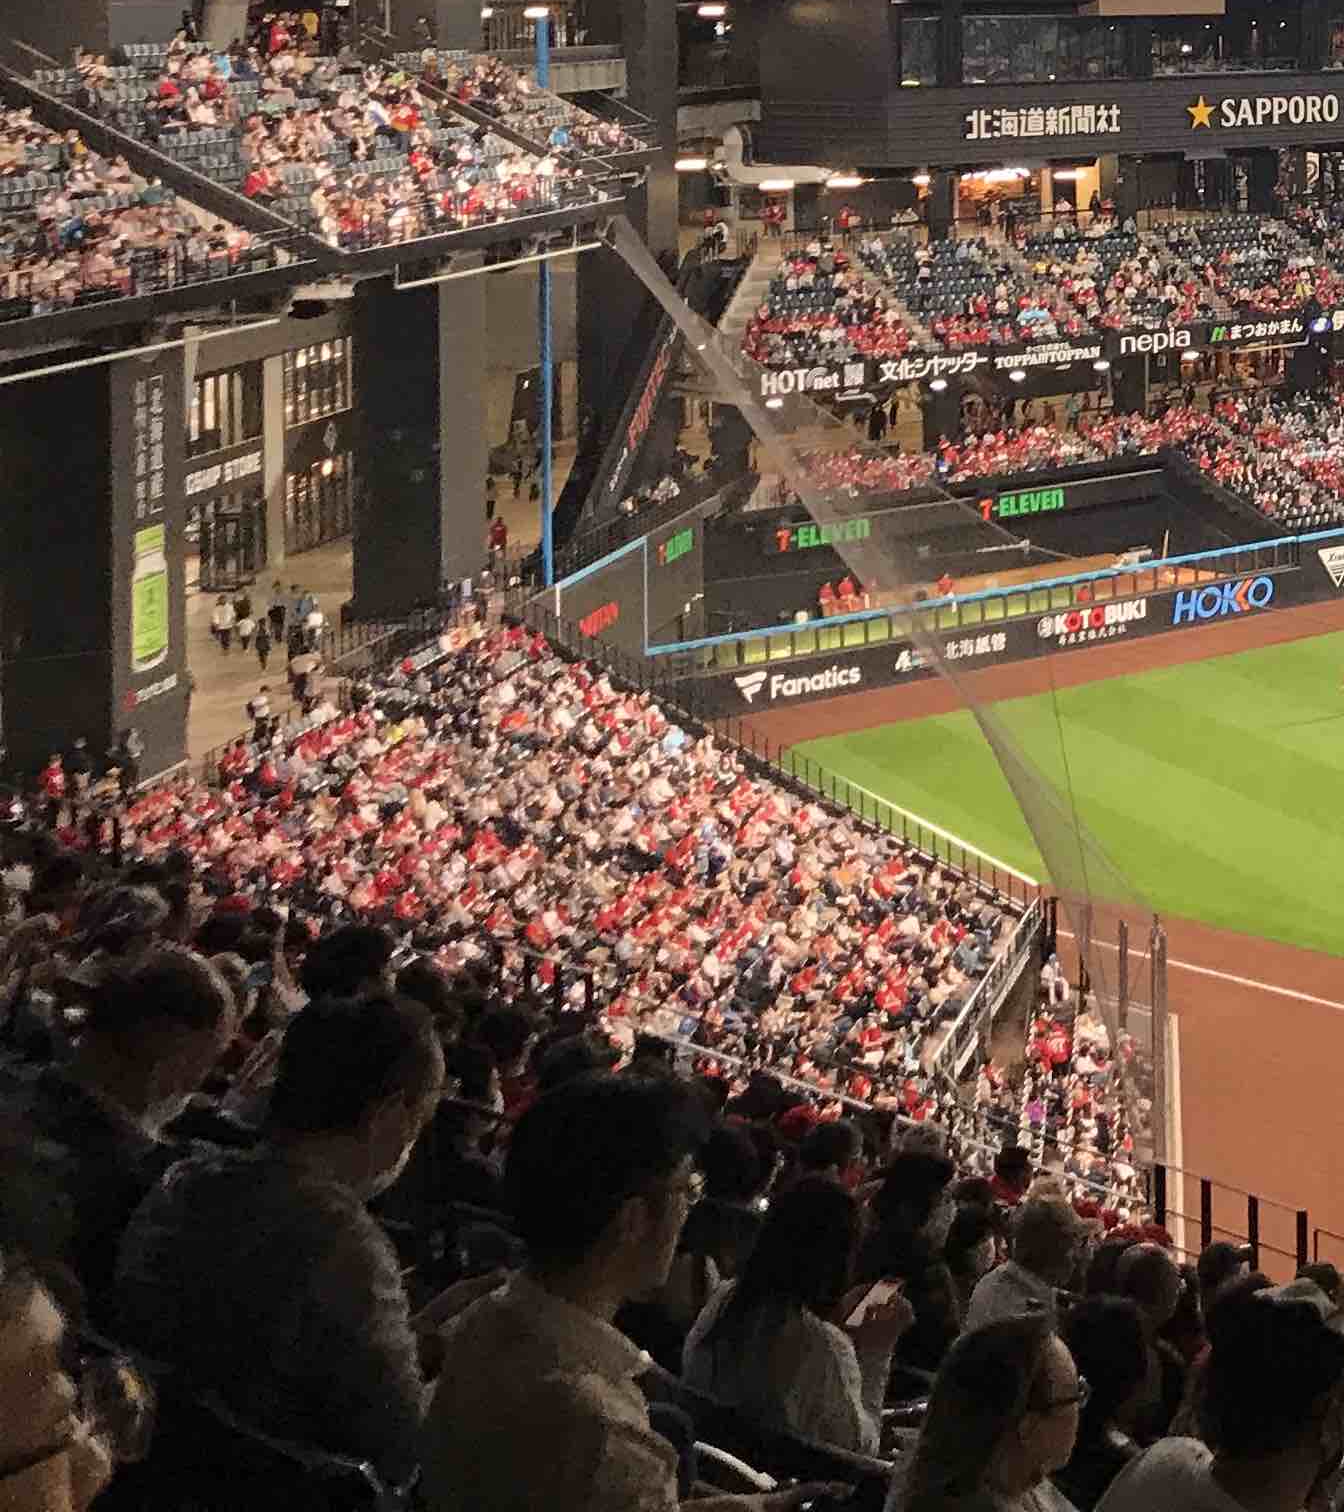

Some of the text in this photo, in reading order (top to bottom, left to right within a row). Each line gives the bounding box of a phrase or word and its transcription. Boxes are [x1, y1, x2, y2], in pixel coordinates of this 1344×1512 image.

[966, 104, 1121, 139] 北海道新聞社
[1220, 94, 1339, 128] SAPPORO
[1120, 327, 1192, 355] nepia
[1230, 318, 1304, 340] まつおかまん
[979, 487, 1065, 522] 7-ELEVEN
[1053, 599, 1146, 637] KOTOBUKI
[770, 664, 862, 700] Fanatics
